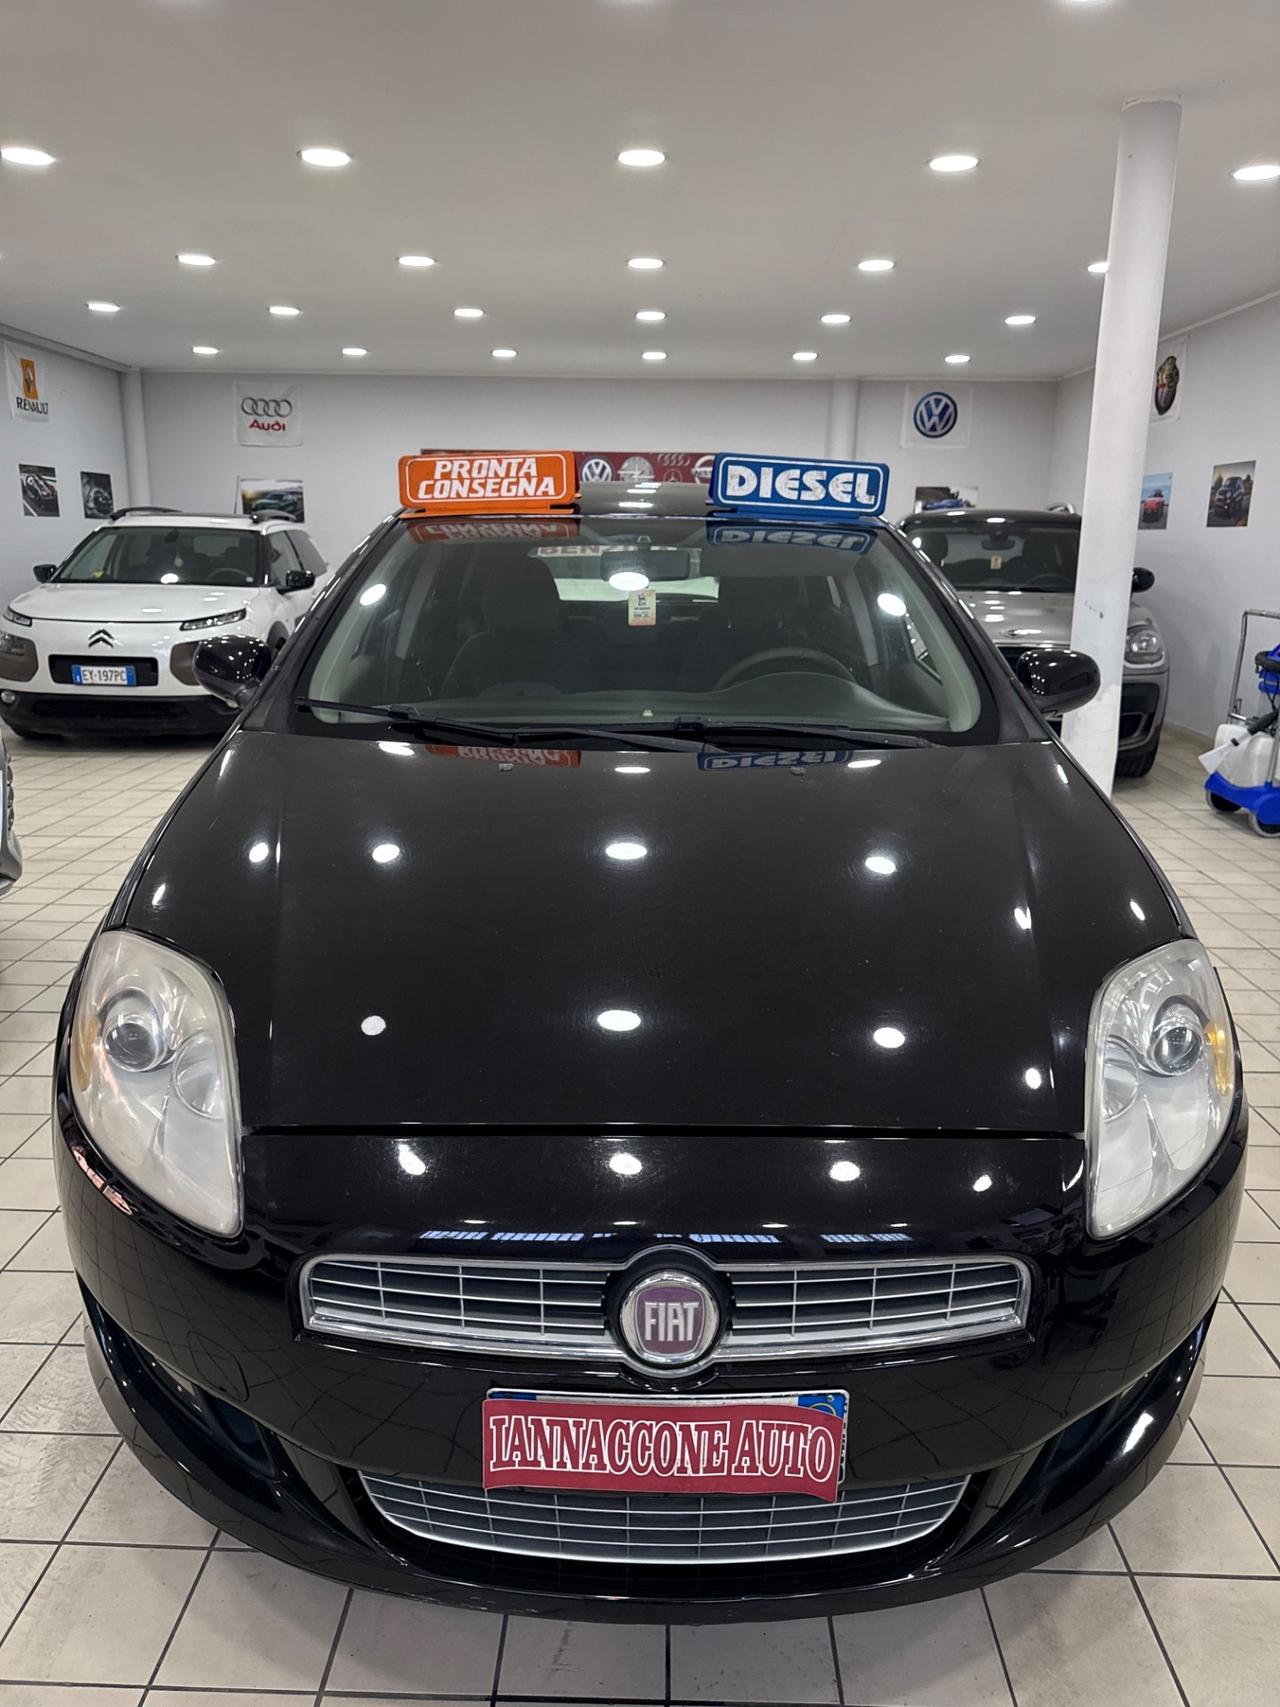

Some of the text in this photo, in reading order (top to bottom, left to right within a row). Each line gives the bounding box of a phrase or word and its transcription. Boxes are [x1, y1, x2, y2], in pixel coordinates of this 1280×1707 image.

[249, 419, 286, 431] Audi
[434, 457, 538, 479] PRONTA
[417, 477, 555, 499] CONSEGNA
[726, 465, 875, 504] DIESEL
[645, 1302, 699, 1342] FIAT
[490, 1415, 731, 1477] IANNACCONE
[732, 1420, 835, 1482] AUTO
